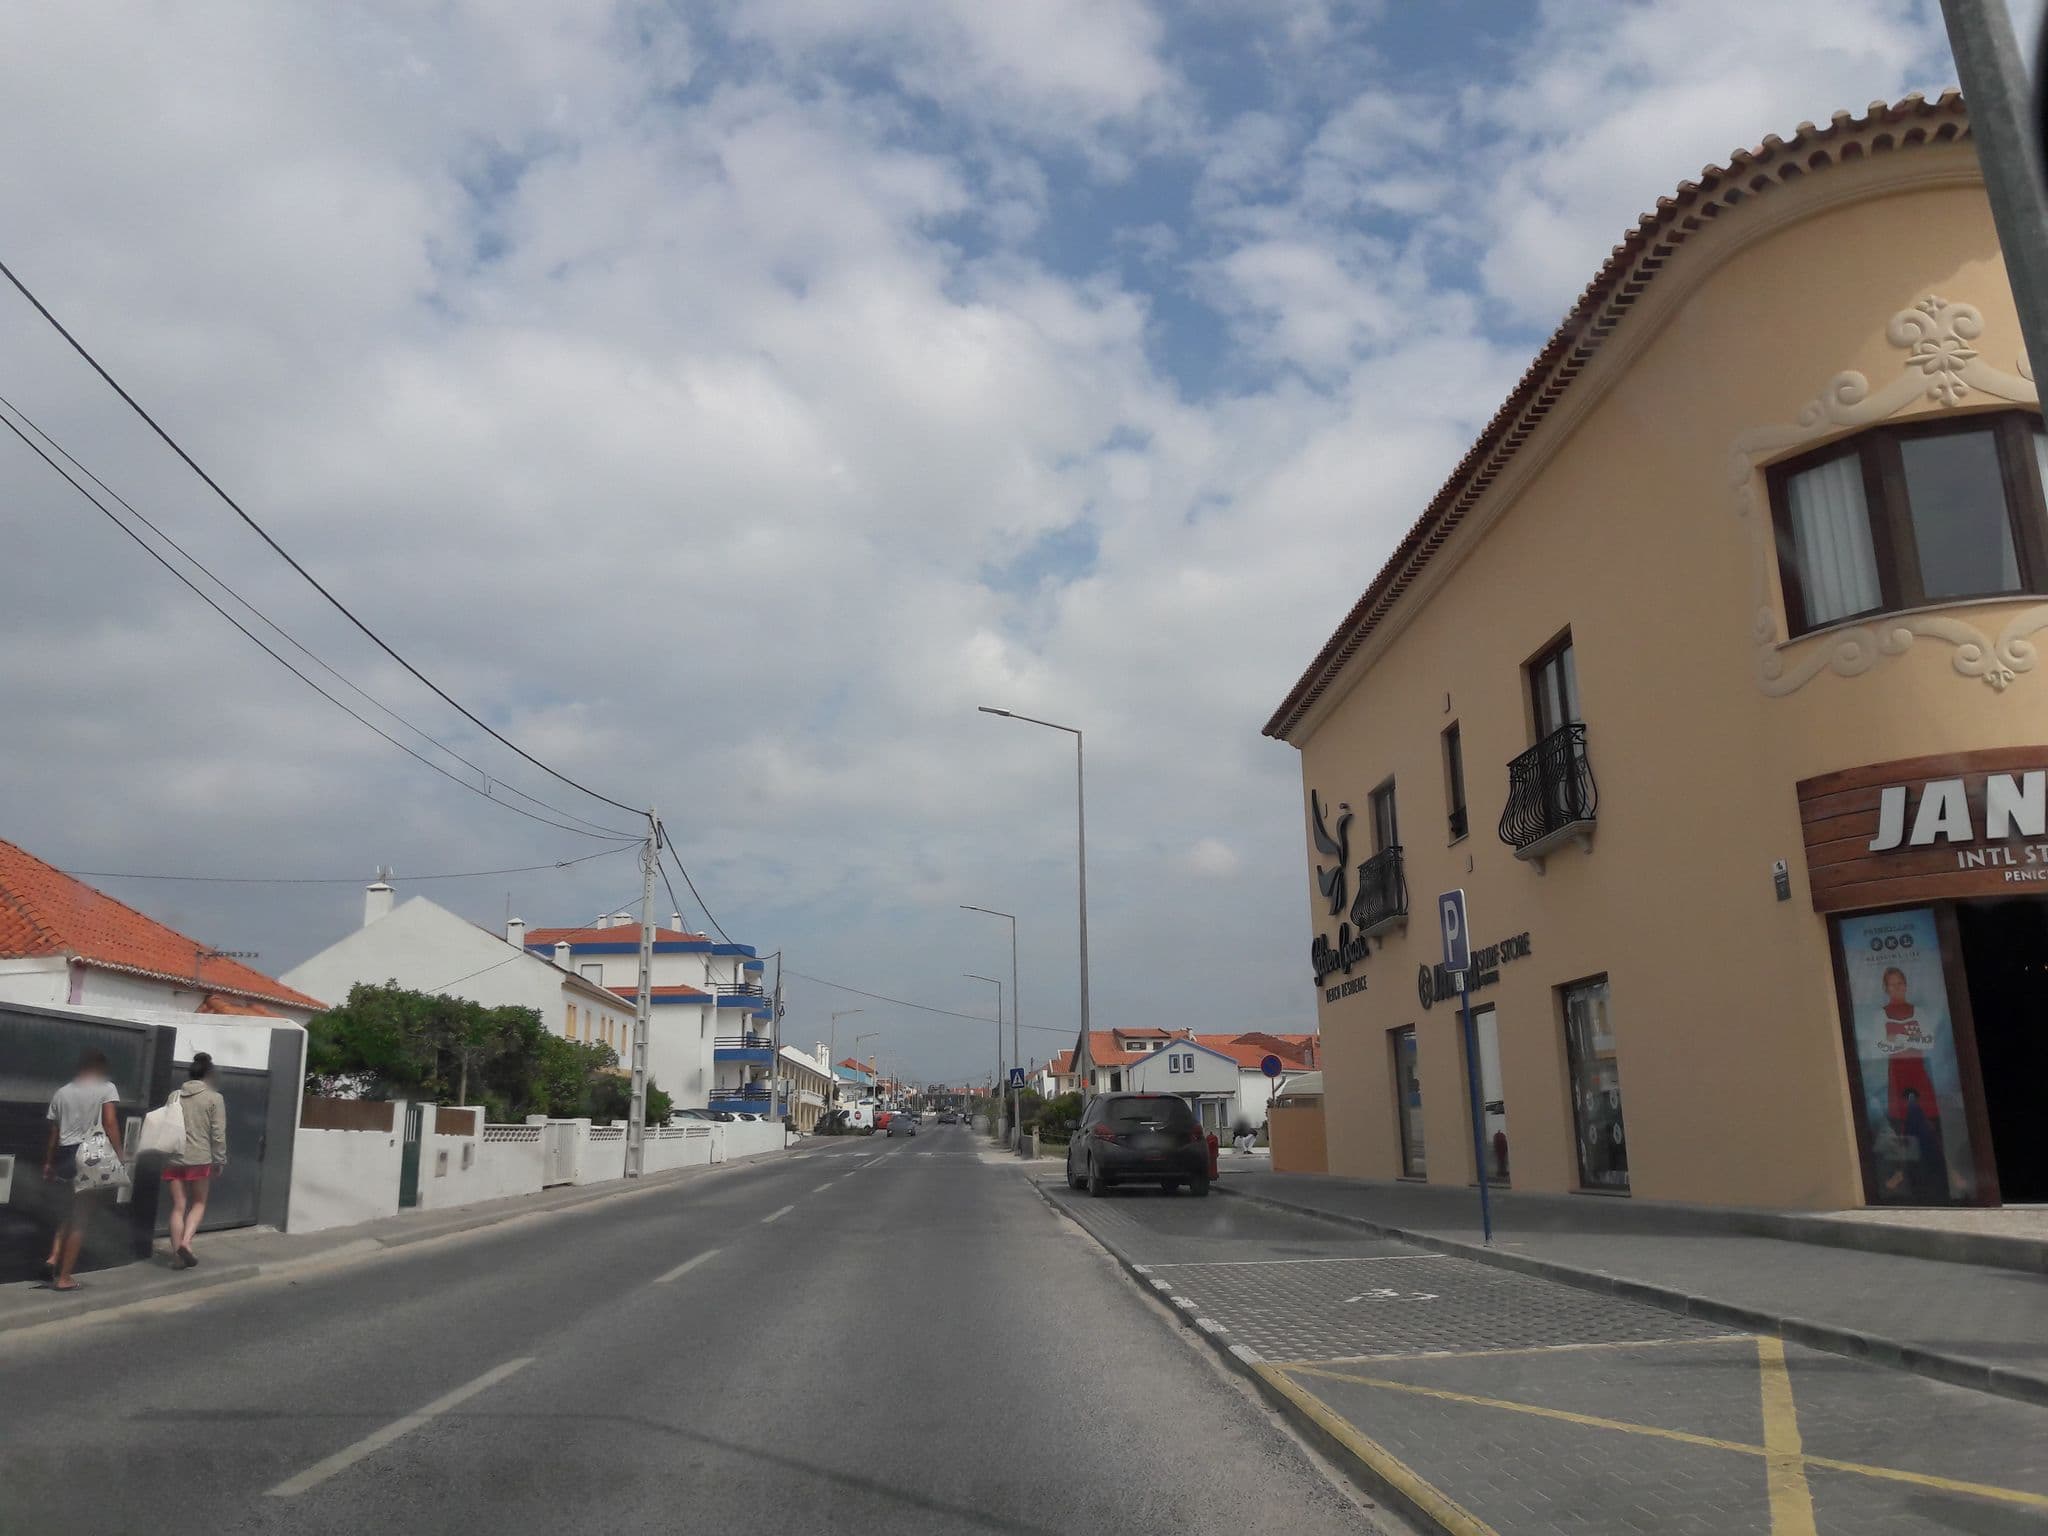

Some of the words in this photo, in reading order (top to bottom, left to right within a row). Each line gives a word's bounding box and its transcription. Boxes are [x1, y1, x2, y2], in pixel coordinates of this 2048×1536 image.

[1869, 770, 2046, 852] JAN
[1957, 847, 2017, 869] INTL
[2004, 869, 2048, 881] PENIC
[1443, 900, 1460, 963] P
